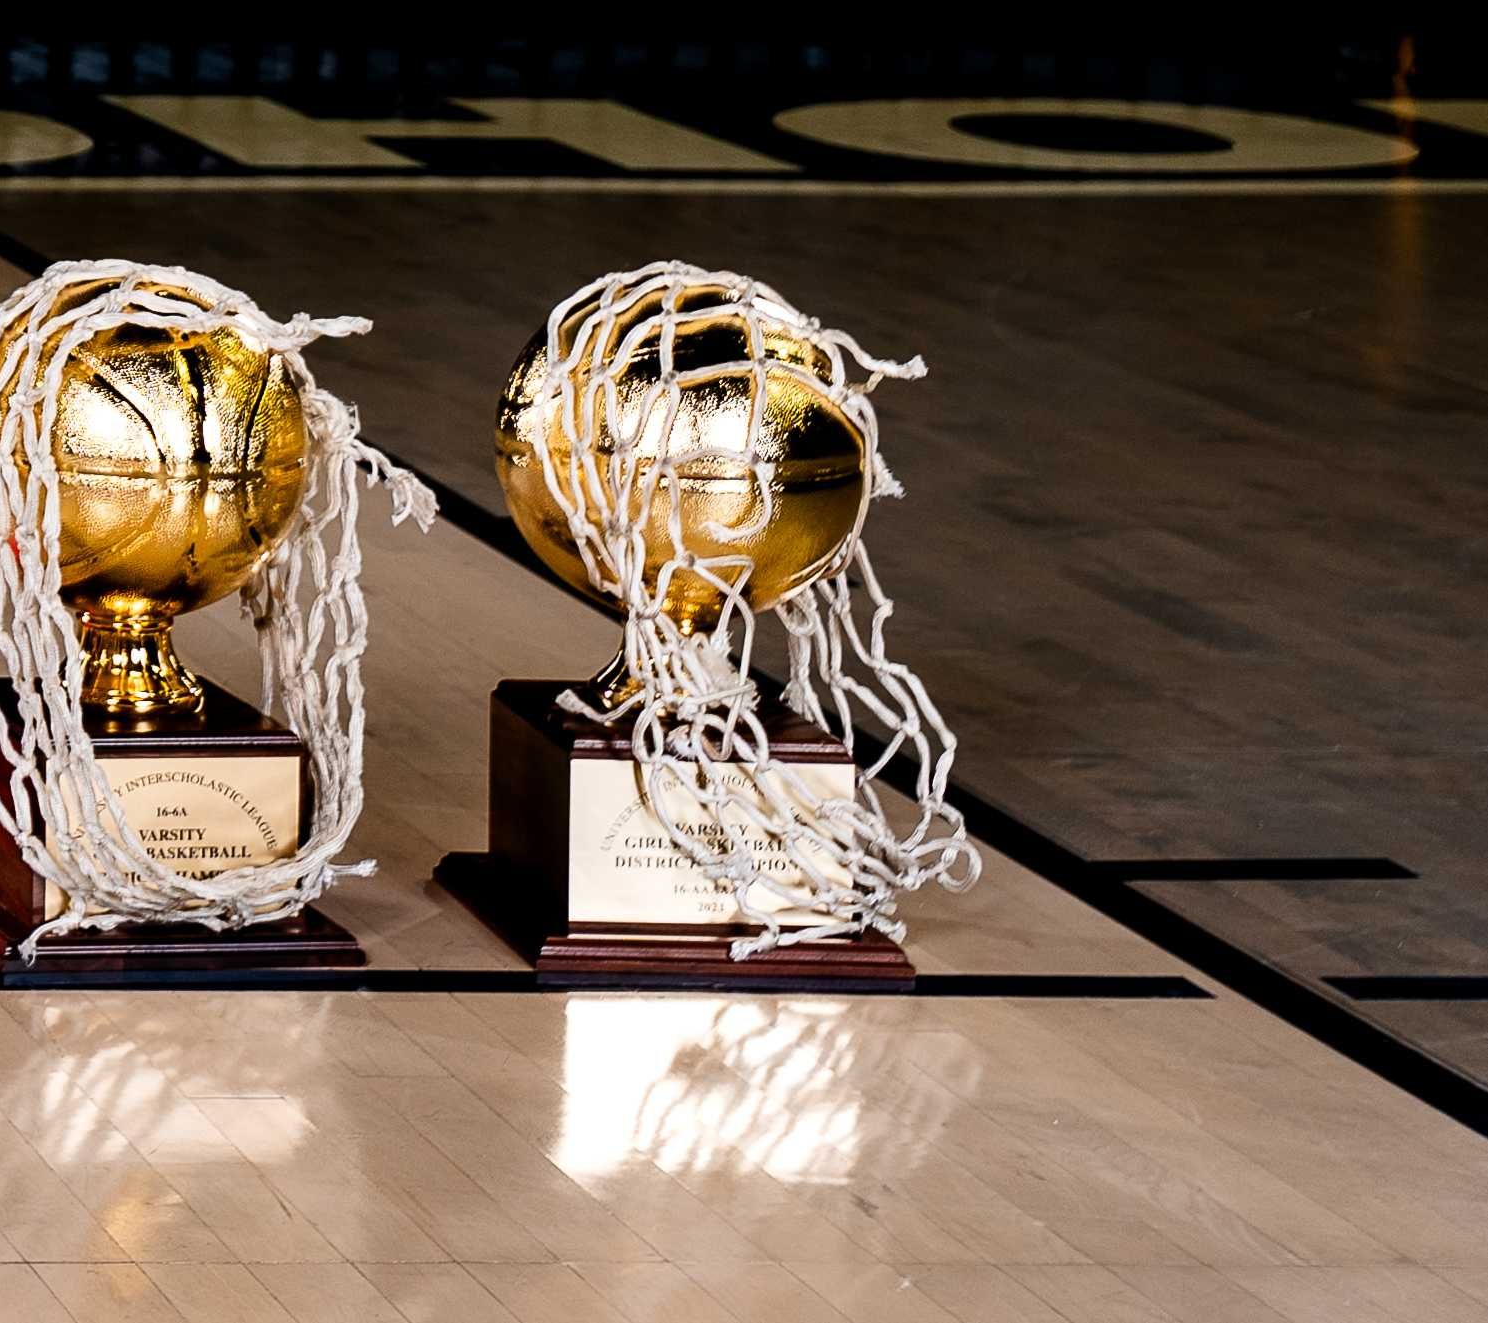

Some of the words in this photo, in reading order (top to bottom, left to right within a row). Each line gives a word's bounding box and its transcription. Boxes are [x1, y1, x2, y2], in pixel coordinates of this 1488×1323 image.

[125, 771, 244, 802] INTERSCHOLASTIC
[240, 800, 278, 850] LEAGUE
[139, 828, 206, 842] VARSITY
